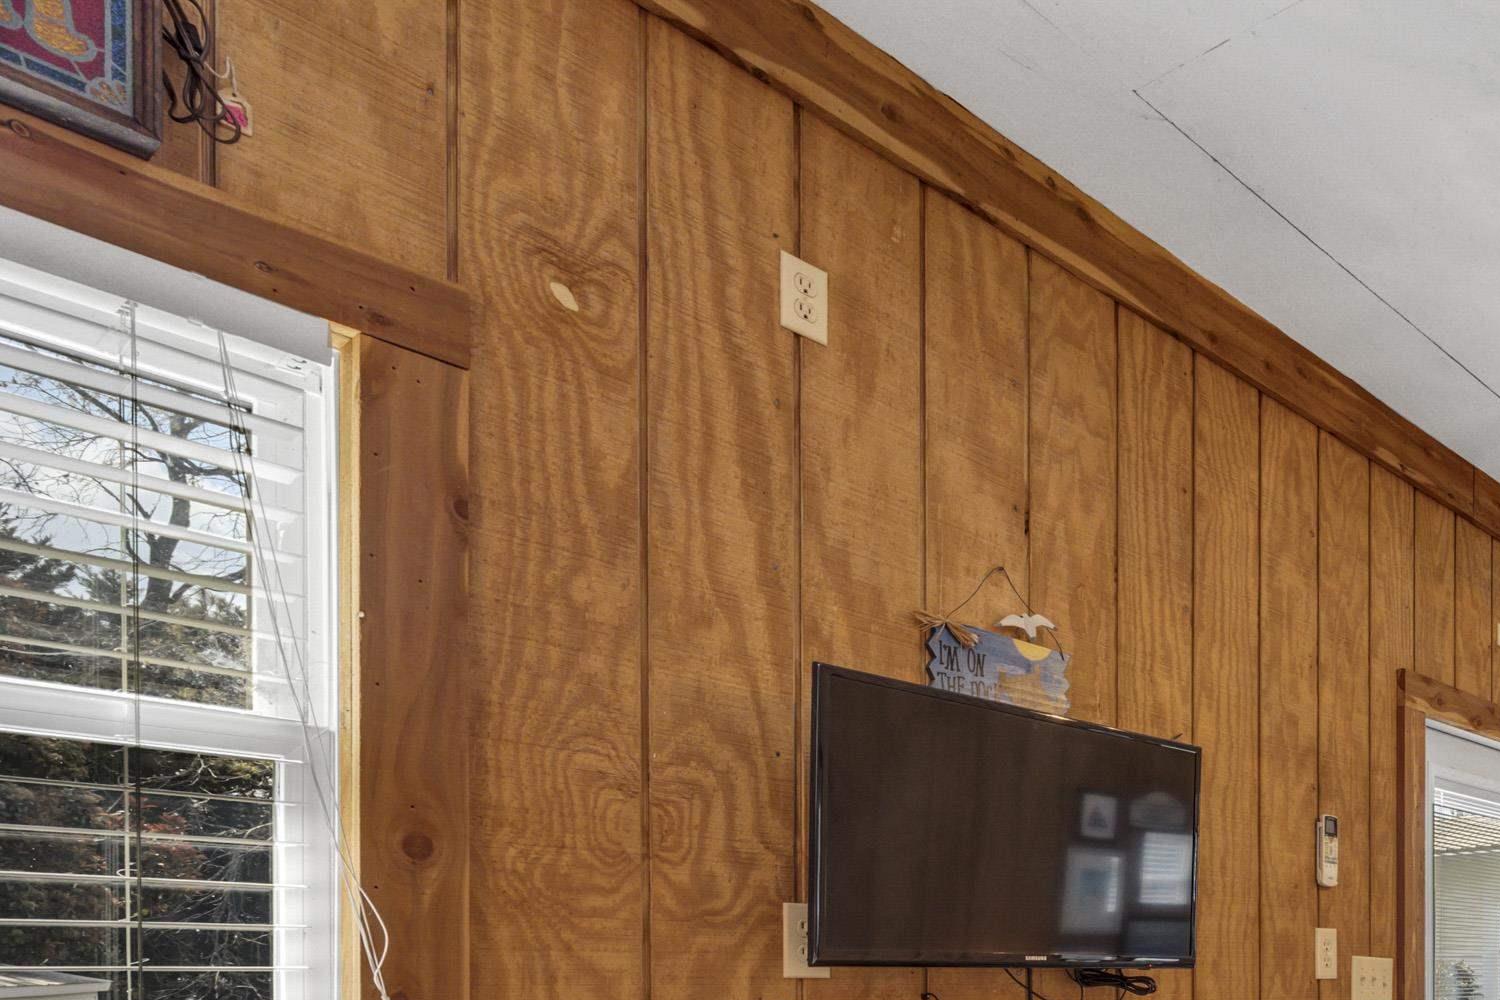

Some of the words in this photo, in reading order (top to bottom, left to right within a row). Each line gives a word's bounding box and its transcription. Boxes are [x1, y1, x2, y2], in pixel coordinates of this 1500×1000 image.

[938, 640, 961, 672] I'M
[967, 647, 986, 677] ON
[936, 672, 965, 694] THE
